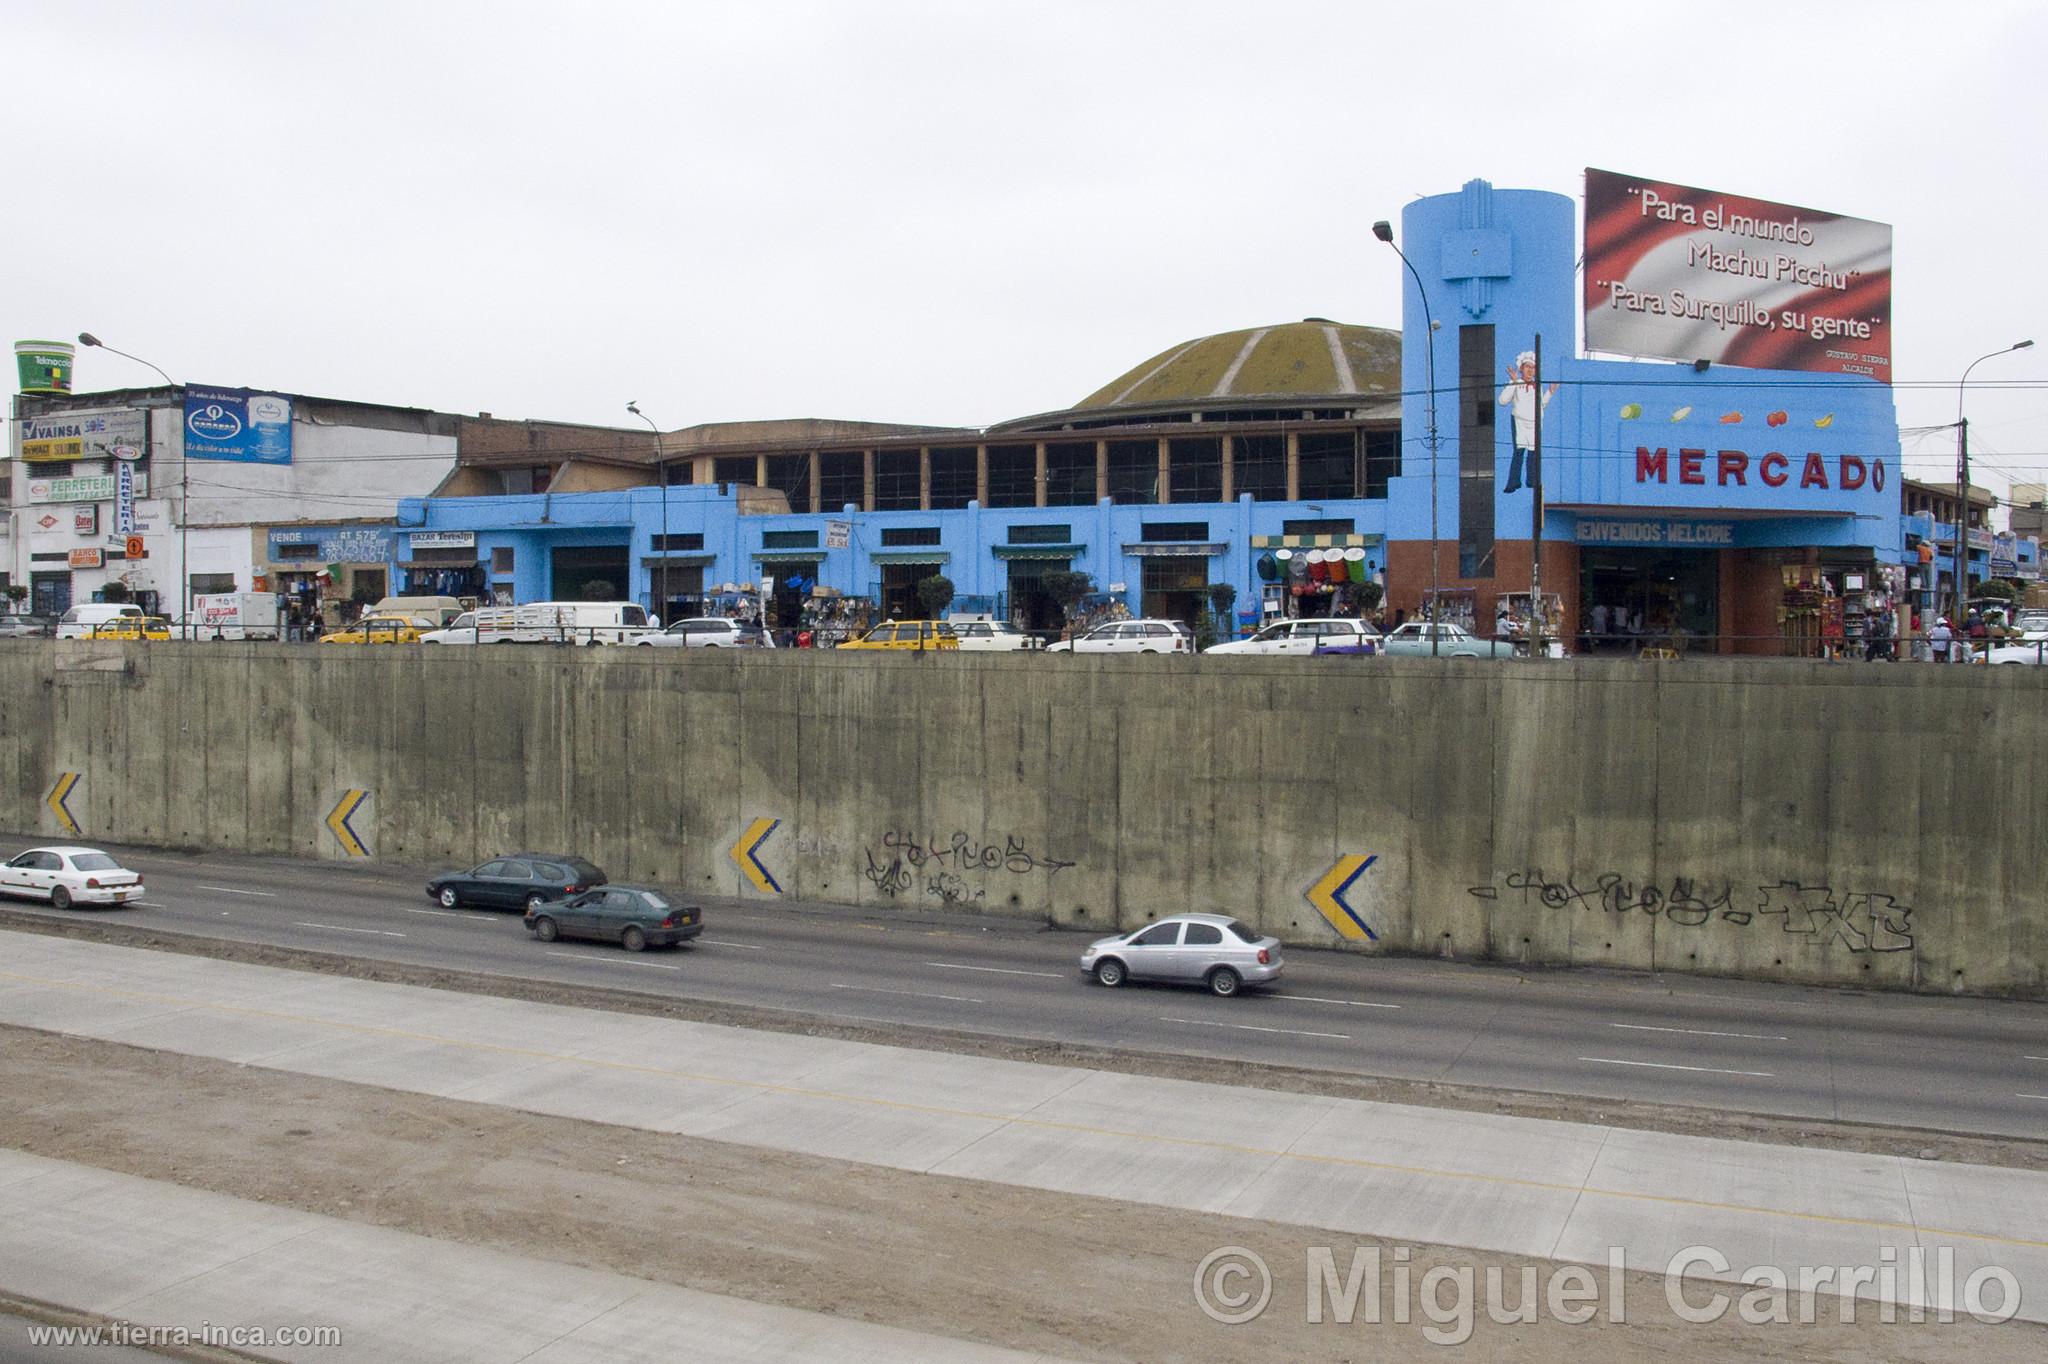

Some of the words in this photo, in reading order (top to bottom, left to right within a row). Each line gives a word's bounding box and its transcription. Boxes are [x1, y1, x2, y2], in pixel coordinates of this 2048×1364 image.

[1703, 204, 1724, 232] el
[1730, 216, 1814, 246] mundo
[1686, 239, 1769, 279] Machu
[1670, 288, 1776, 331] Surquillo,
[1781, 310, 1806, 331] su
[1825, 350, 1859, 361] GUSTAVO
[1862, 354, 1889, 366] SIERRA
[1841, 364, 1874, 375] ALCALDE
[38, 424, 82, 439] VAINSA
[1636, 446, 1885, 493] MERCADO
[51, 477, 115, 493] FERRETERI
[120, 463, 131, 532] FERRETERIA
[270, 532, 303, 543] VENDE
[1667, 524, 1733, 543] WELCOME
